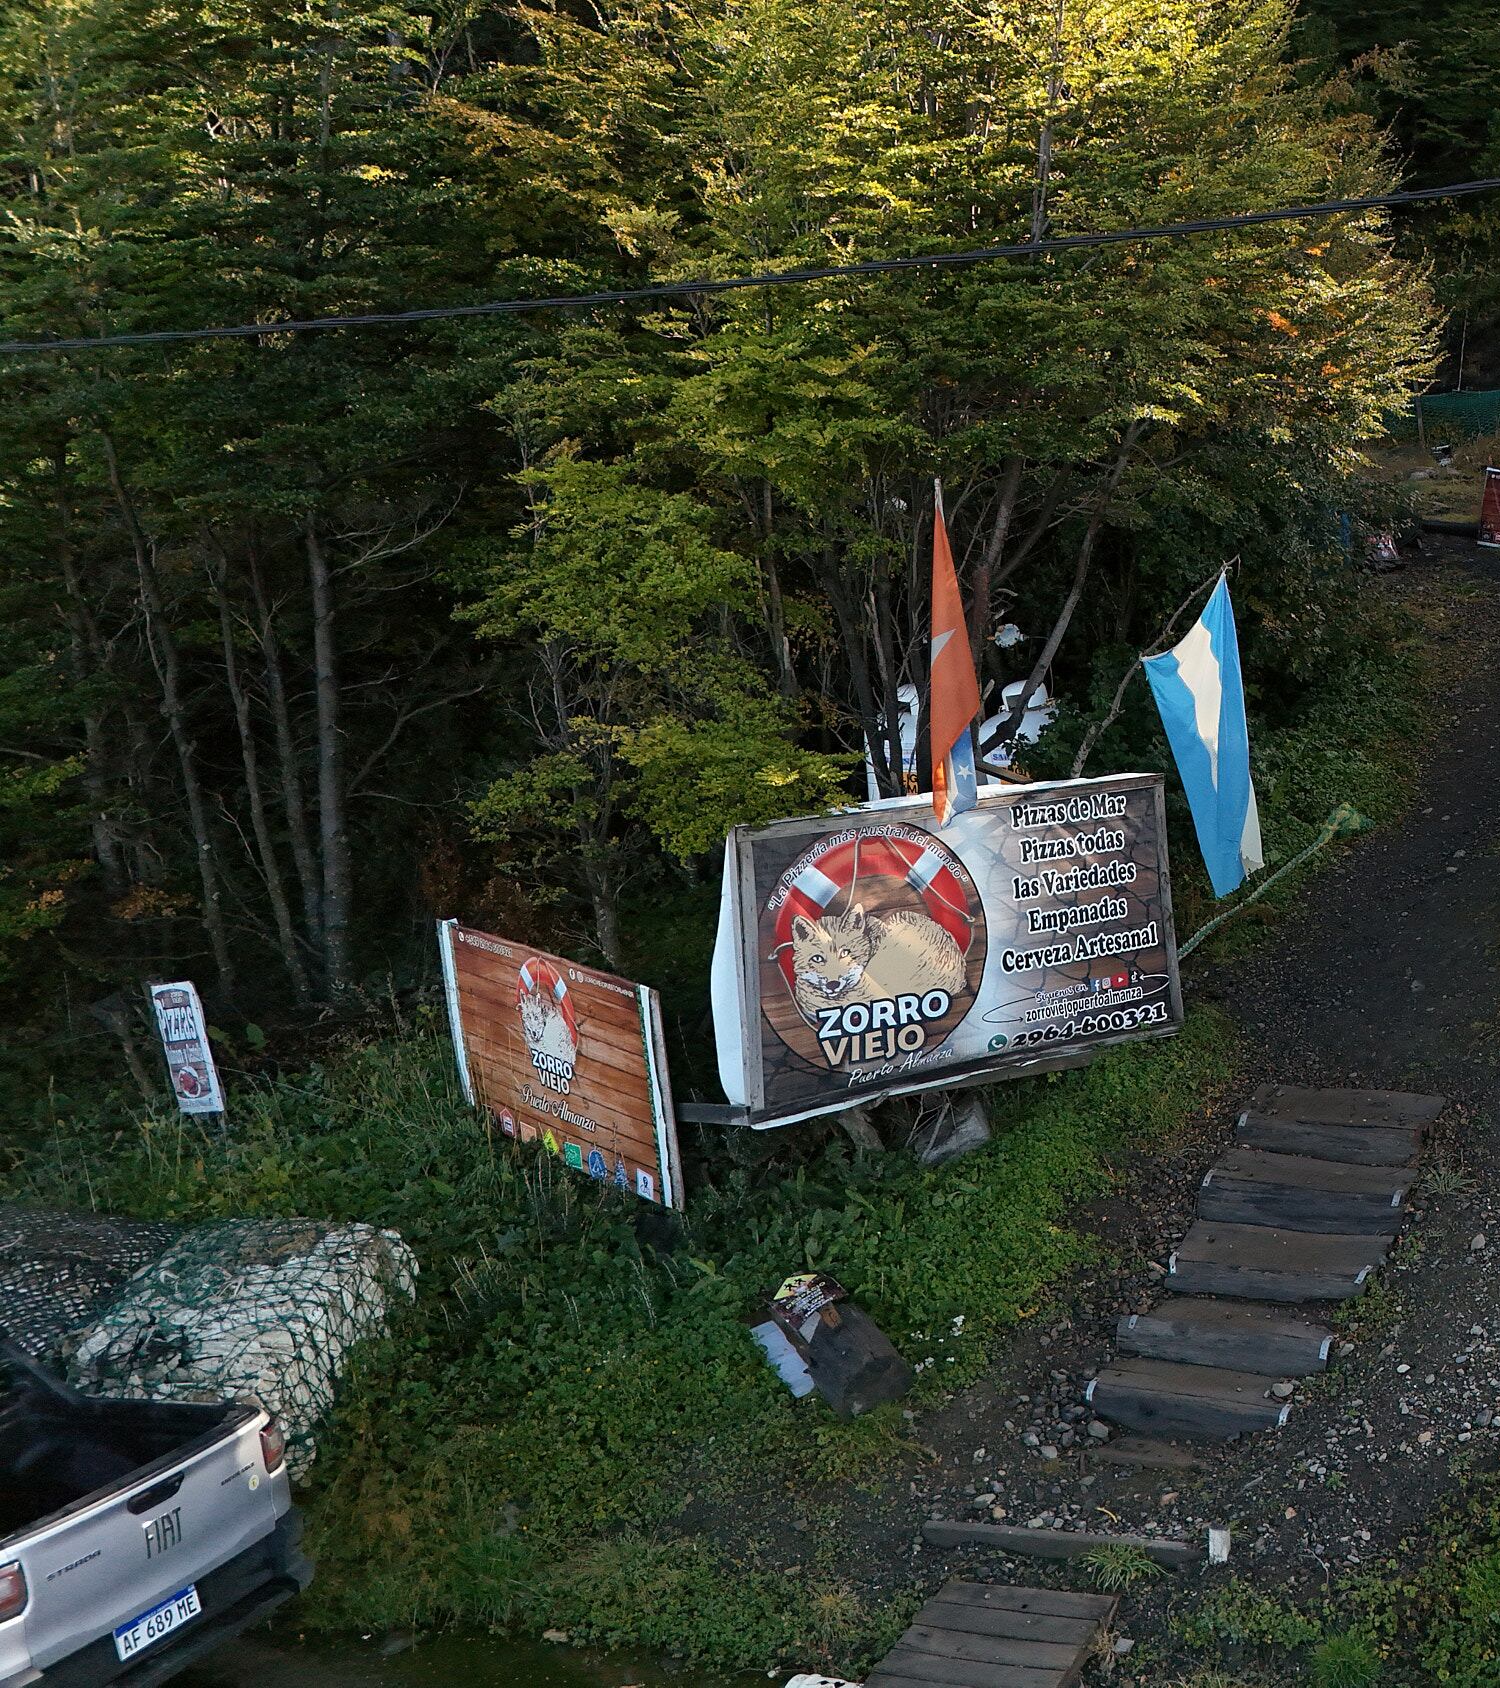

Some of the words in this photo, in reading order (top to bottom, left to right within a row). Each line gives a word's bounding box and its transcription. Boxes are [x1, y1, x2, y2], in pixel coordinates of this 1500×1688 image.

[1011, 804, 1065, 828] Pizzas
[1069, 798, 1089, 821] de
[1092, 794, 1126, 817] Mar
[860, 825, 906, 838] Austral
[908, 827, 928, 846] del
[1020, 838, 1075, 863] Pizzas
[1076, 828, 1124, 853] todas
[1013, 878, 1040, 900] las
[1042, 862, 1135, 895] Variedades
[1029, 898, 1127, 932] Empanadas
[1002, 944, 1071, 972] Cerveza
[1075, 923, 1157, 959] Artesanal
[1026, 987, 1142, 1022] zorroviejopuertoalmanza
[1075, 983, 1088, 993] en
[818, 991, 949, 1039] ZORRO
[1012, 1003, 1167, 1047] 2964-600321
[532, 1049, 573, 1079] ZORRO
[822, 1024, 925, 1066] VIEJO
[538, 1068, 570, 1095] VIEJO
[848, 1062, 894, 1087] Puerto
[899, 1048, 953, 1073] Almanza
[522, 1084, 550, 1113] Puerto
[552, 1100, 596, 1133] Almanza
[142, 1507, 181, 1559] FIAT
[123, 1628, 141, 1654] AF
[147, 1609, 173, 1638] 689
[177, 1595, 197, 1620] ME
